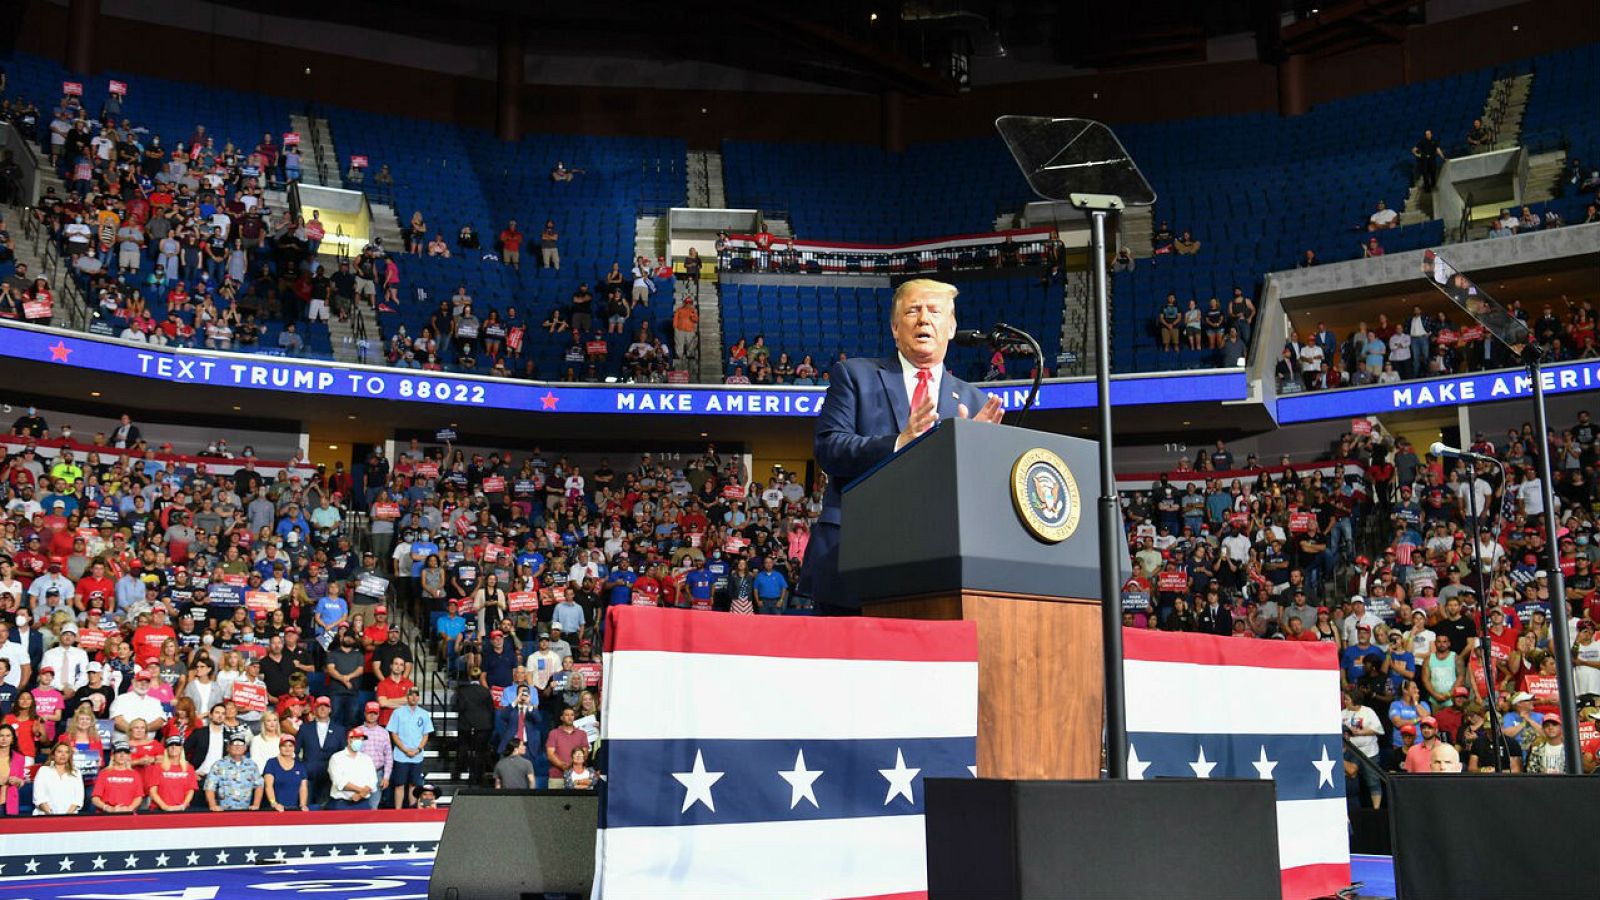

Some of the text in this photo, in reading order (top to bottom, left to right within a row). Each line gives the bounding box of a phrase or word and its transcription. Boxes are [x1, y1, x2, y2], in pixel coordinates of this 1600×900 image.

[137, 353, 485, 403] TEXT TRUMP TO 88022
[1392, 367, 1600, 408] MAKE AMERI
[617, 393, 693, 411] MAKE
